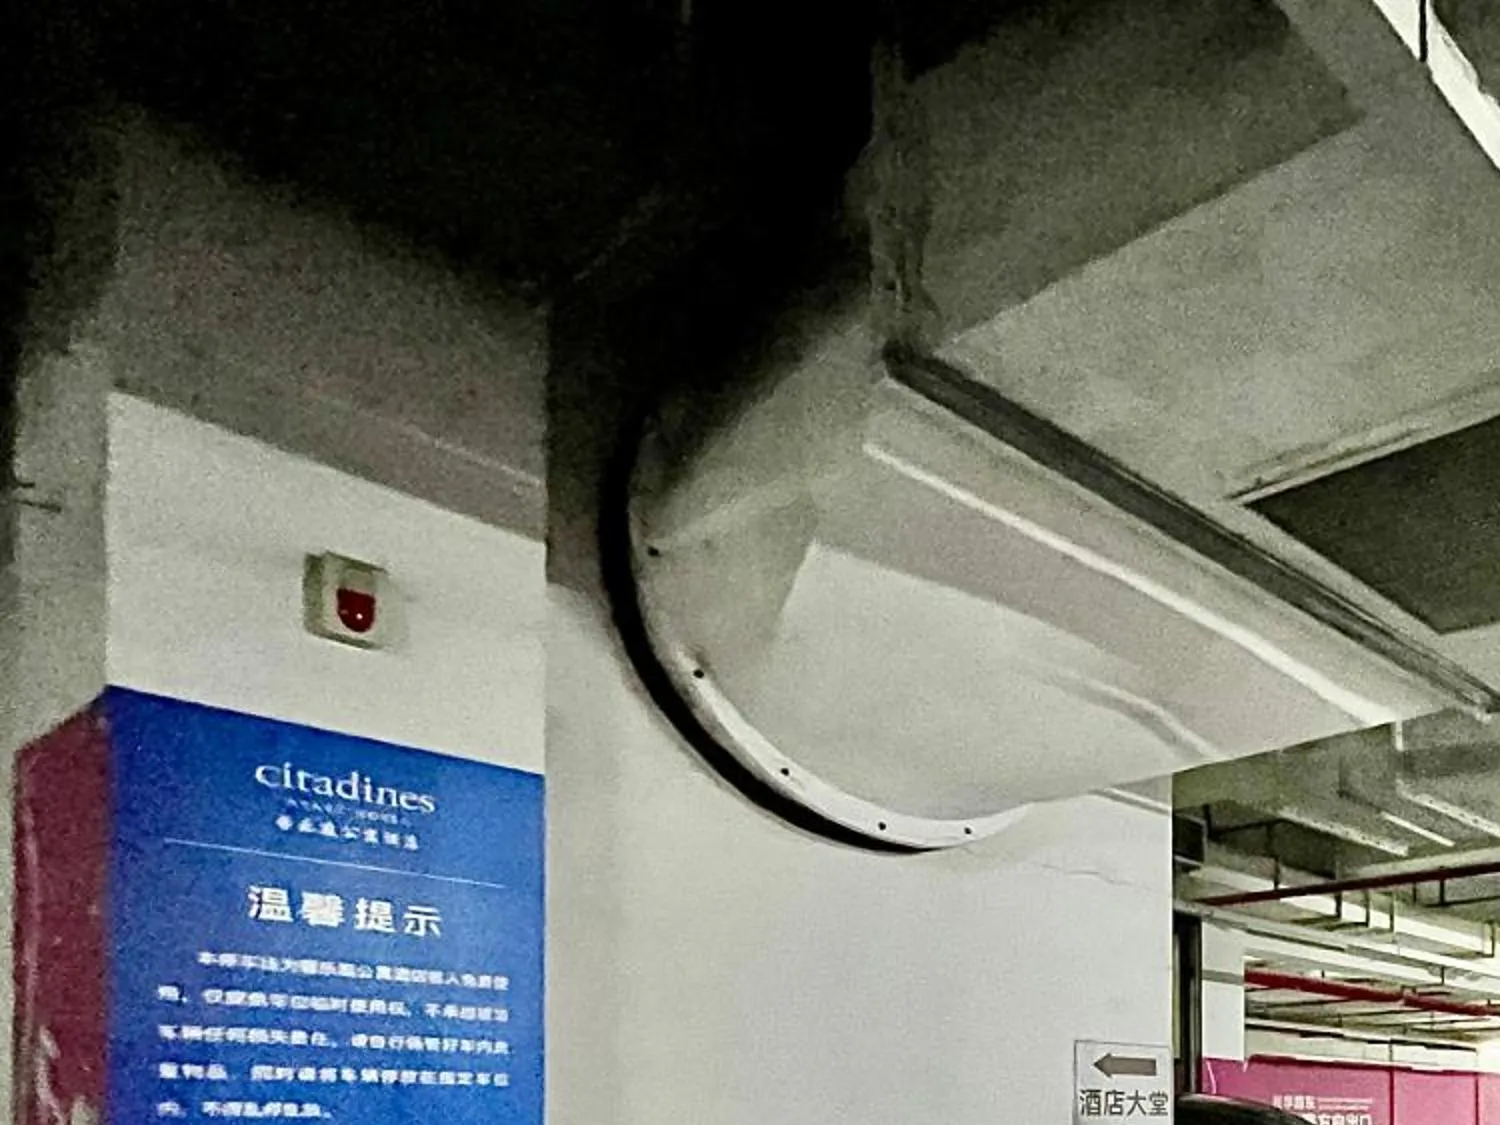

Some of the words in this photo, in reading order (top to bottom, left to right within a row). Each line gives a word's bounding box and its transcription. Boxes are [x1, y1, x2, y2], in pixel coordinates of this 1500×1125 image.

[255, 762, 436, 813] citadines
[248, 884, 442, 937] 温馨提示
[1080, 1088, 1169, 1117] 酒店大堂
